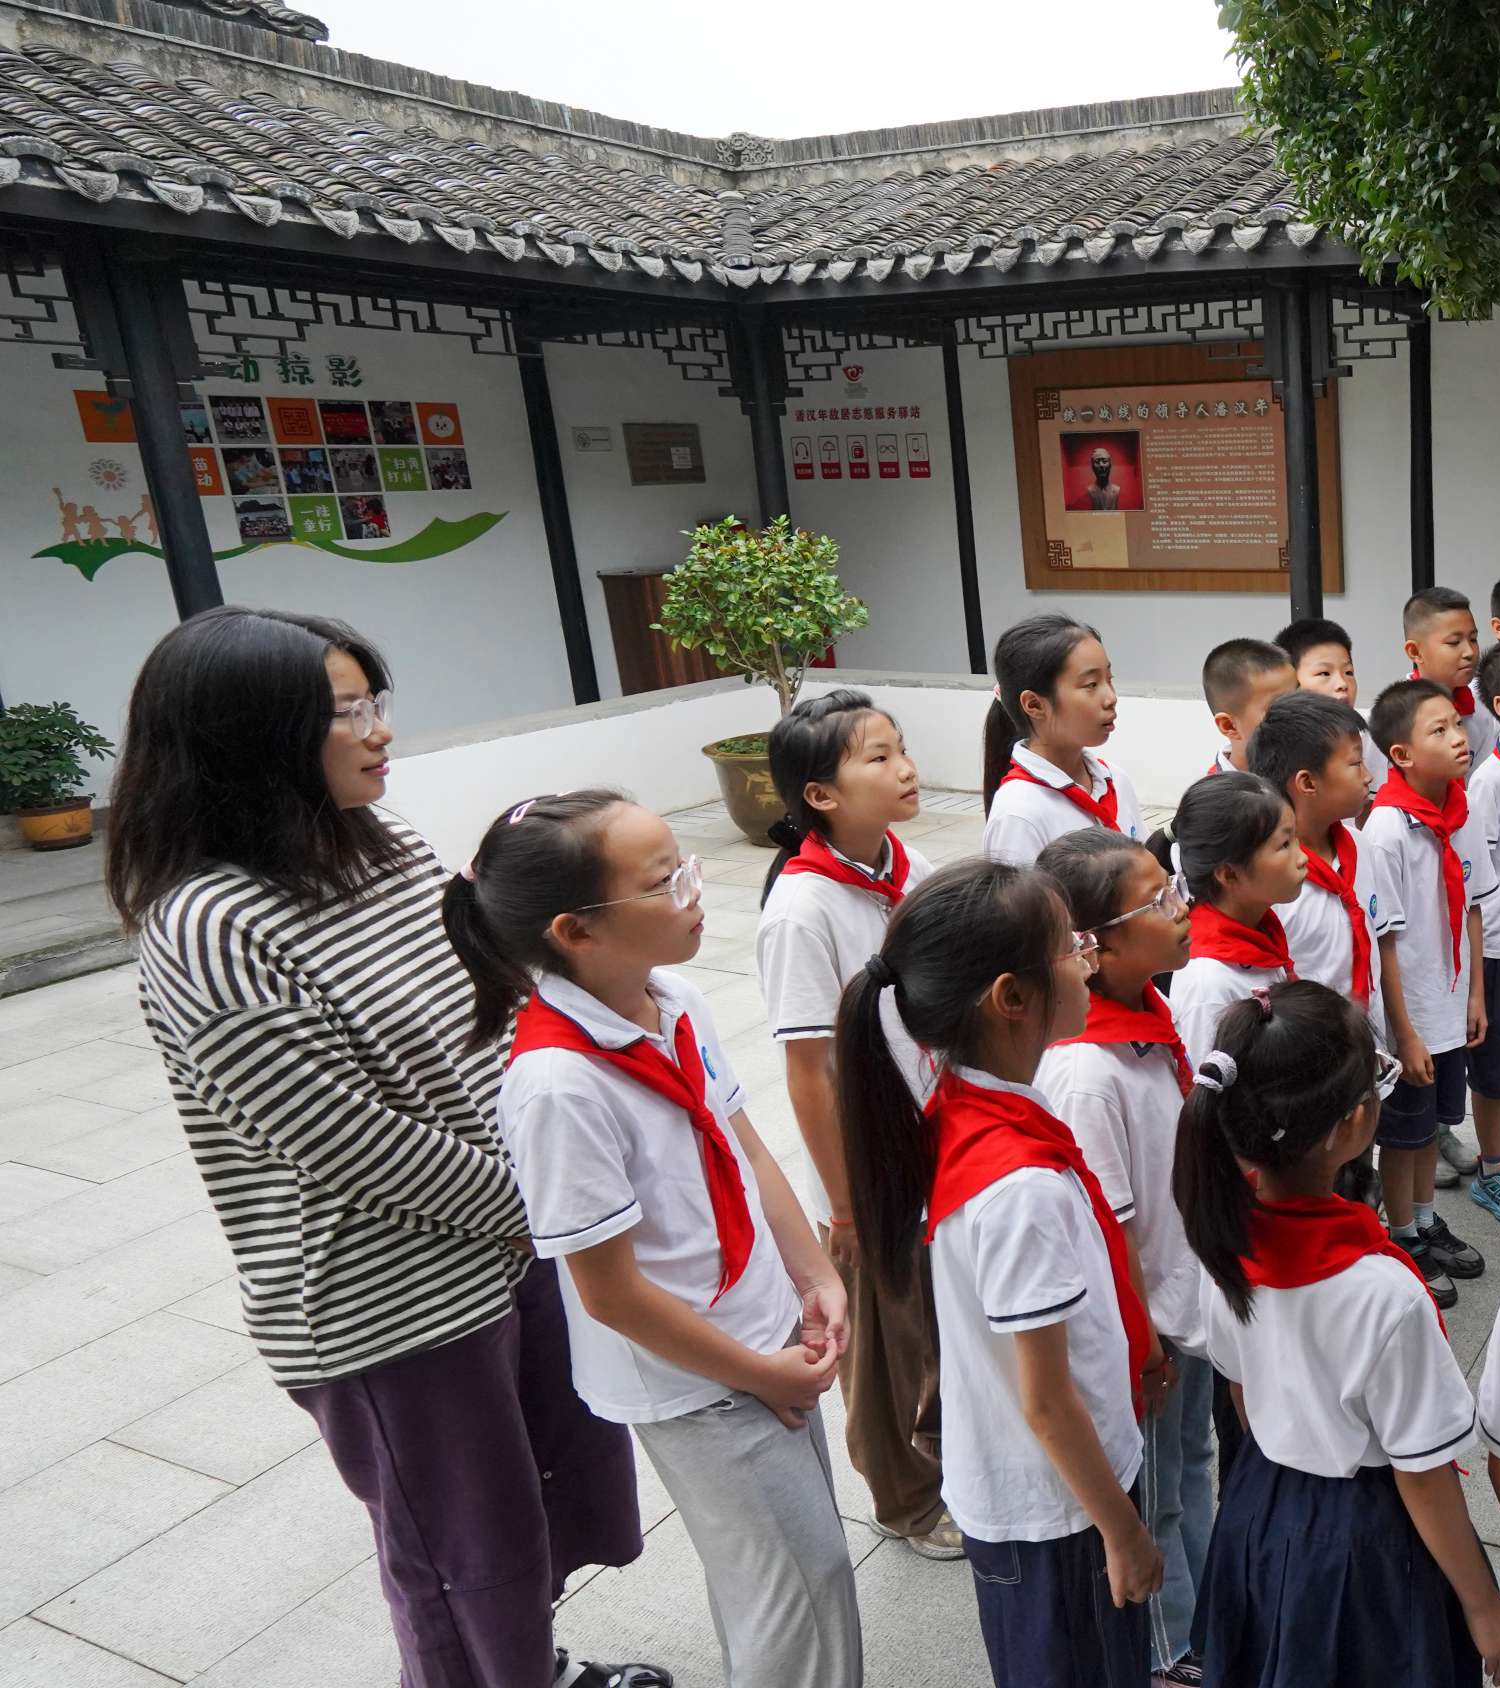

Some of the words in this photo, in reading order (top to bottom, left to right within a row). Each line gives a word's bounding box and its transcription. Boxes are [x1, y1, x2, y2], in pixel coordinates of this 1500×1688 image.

[224, 351, 363, 388] 动掠影
[1062, 399, 1270, 423] 统一战线的领导人潘汉年
